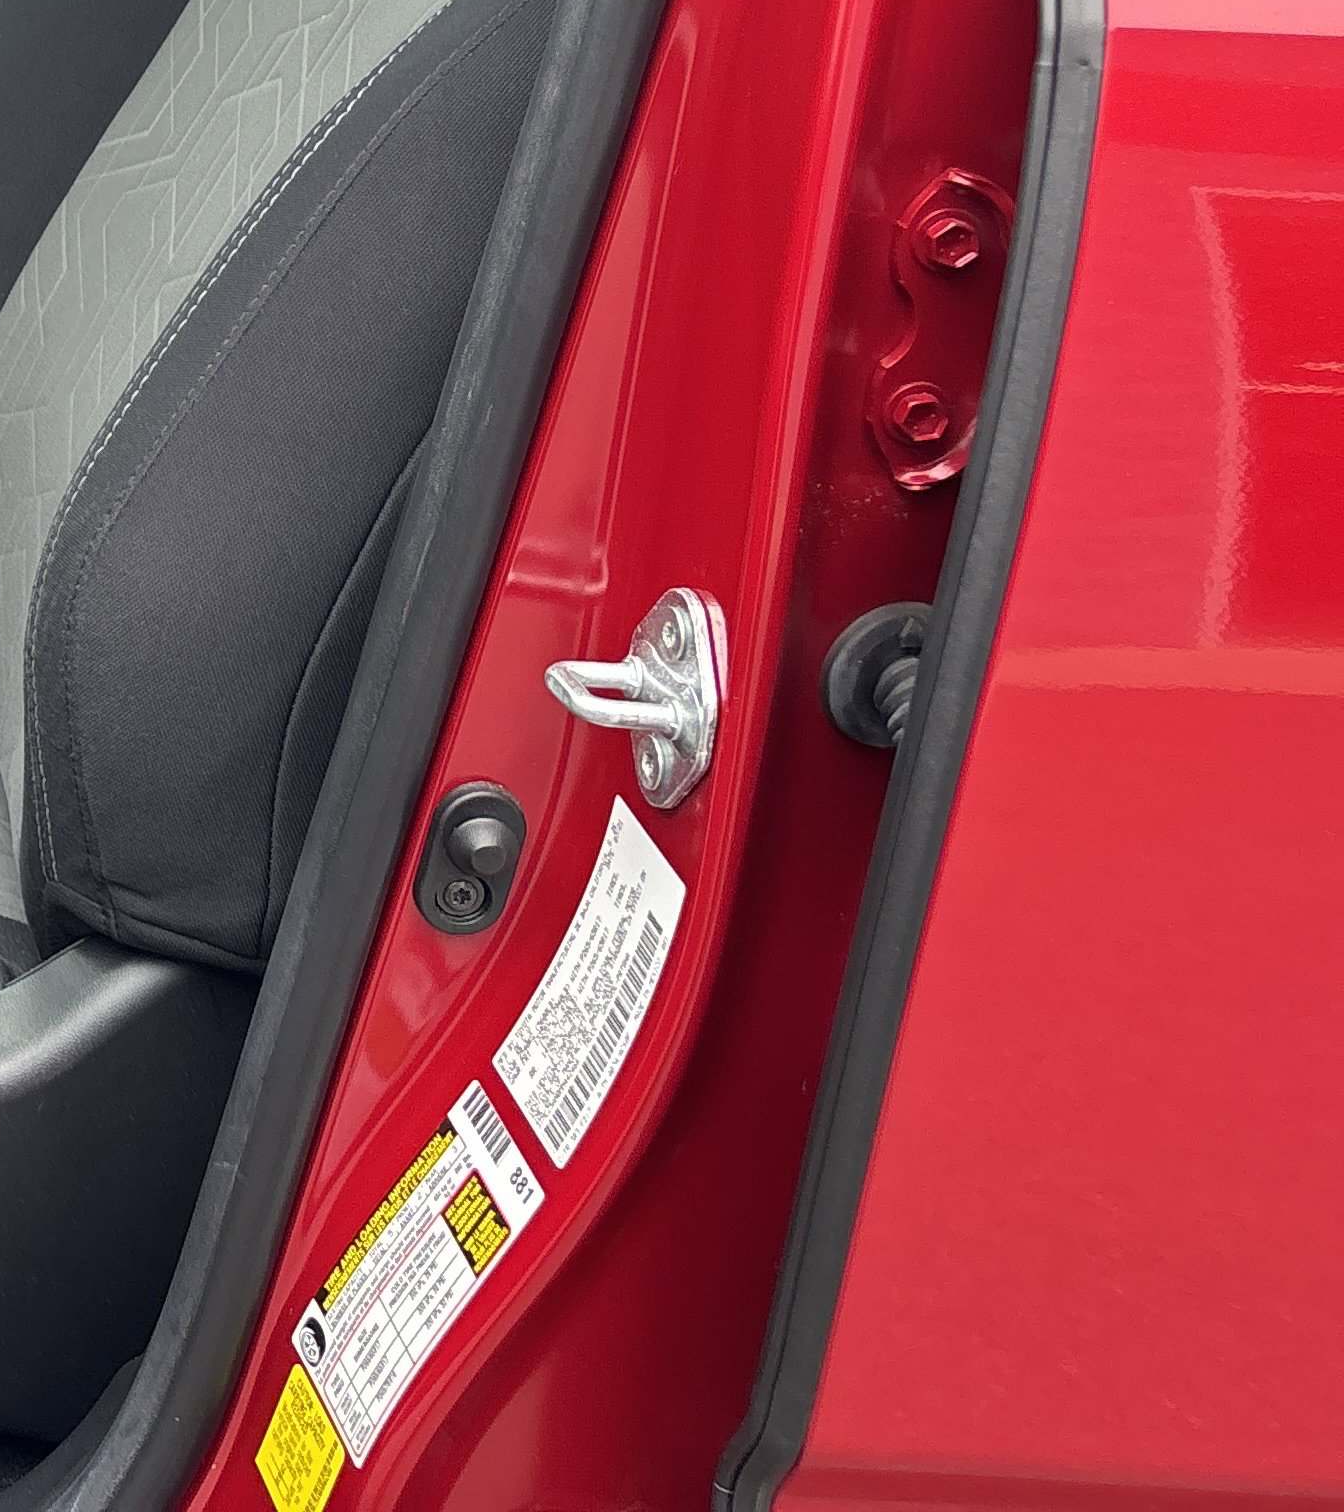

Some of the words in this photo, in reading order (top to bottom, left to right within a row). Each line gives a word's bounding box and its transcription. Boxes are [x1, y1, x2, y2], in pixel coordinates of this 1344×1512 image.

[323, 1264, 342, 1293] TIRE
[339, 1242, 357, 1270] AND
[354, 1197, 390, 1249] LOADING
[387, 1129, 442, 1207] INFORMATION
[363, 1231, 376, 1251] SUR
[373, 1217, 386, 1237] LES
[401, 1186, 410, 1200] ET
[408, 1176, 418, 1191] LE
[508, 1164, 535, 1205] 881
